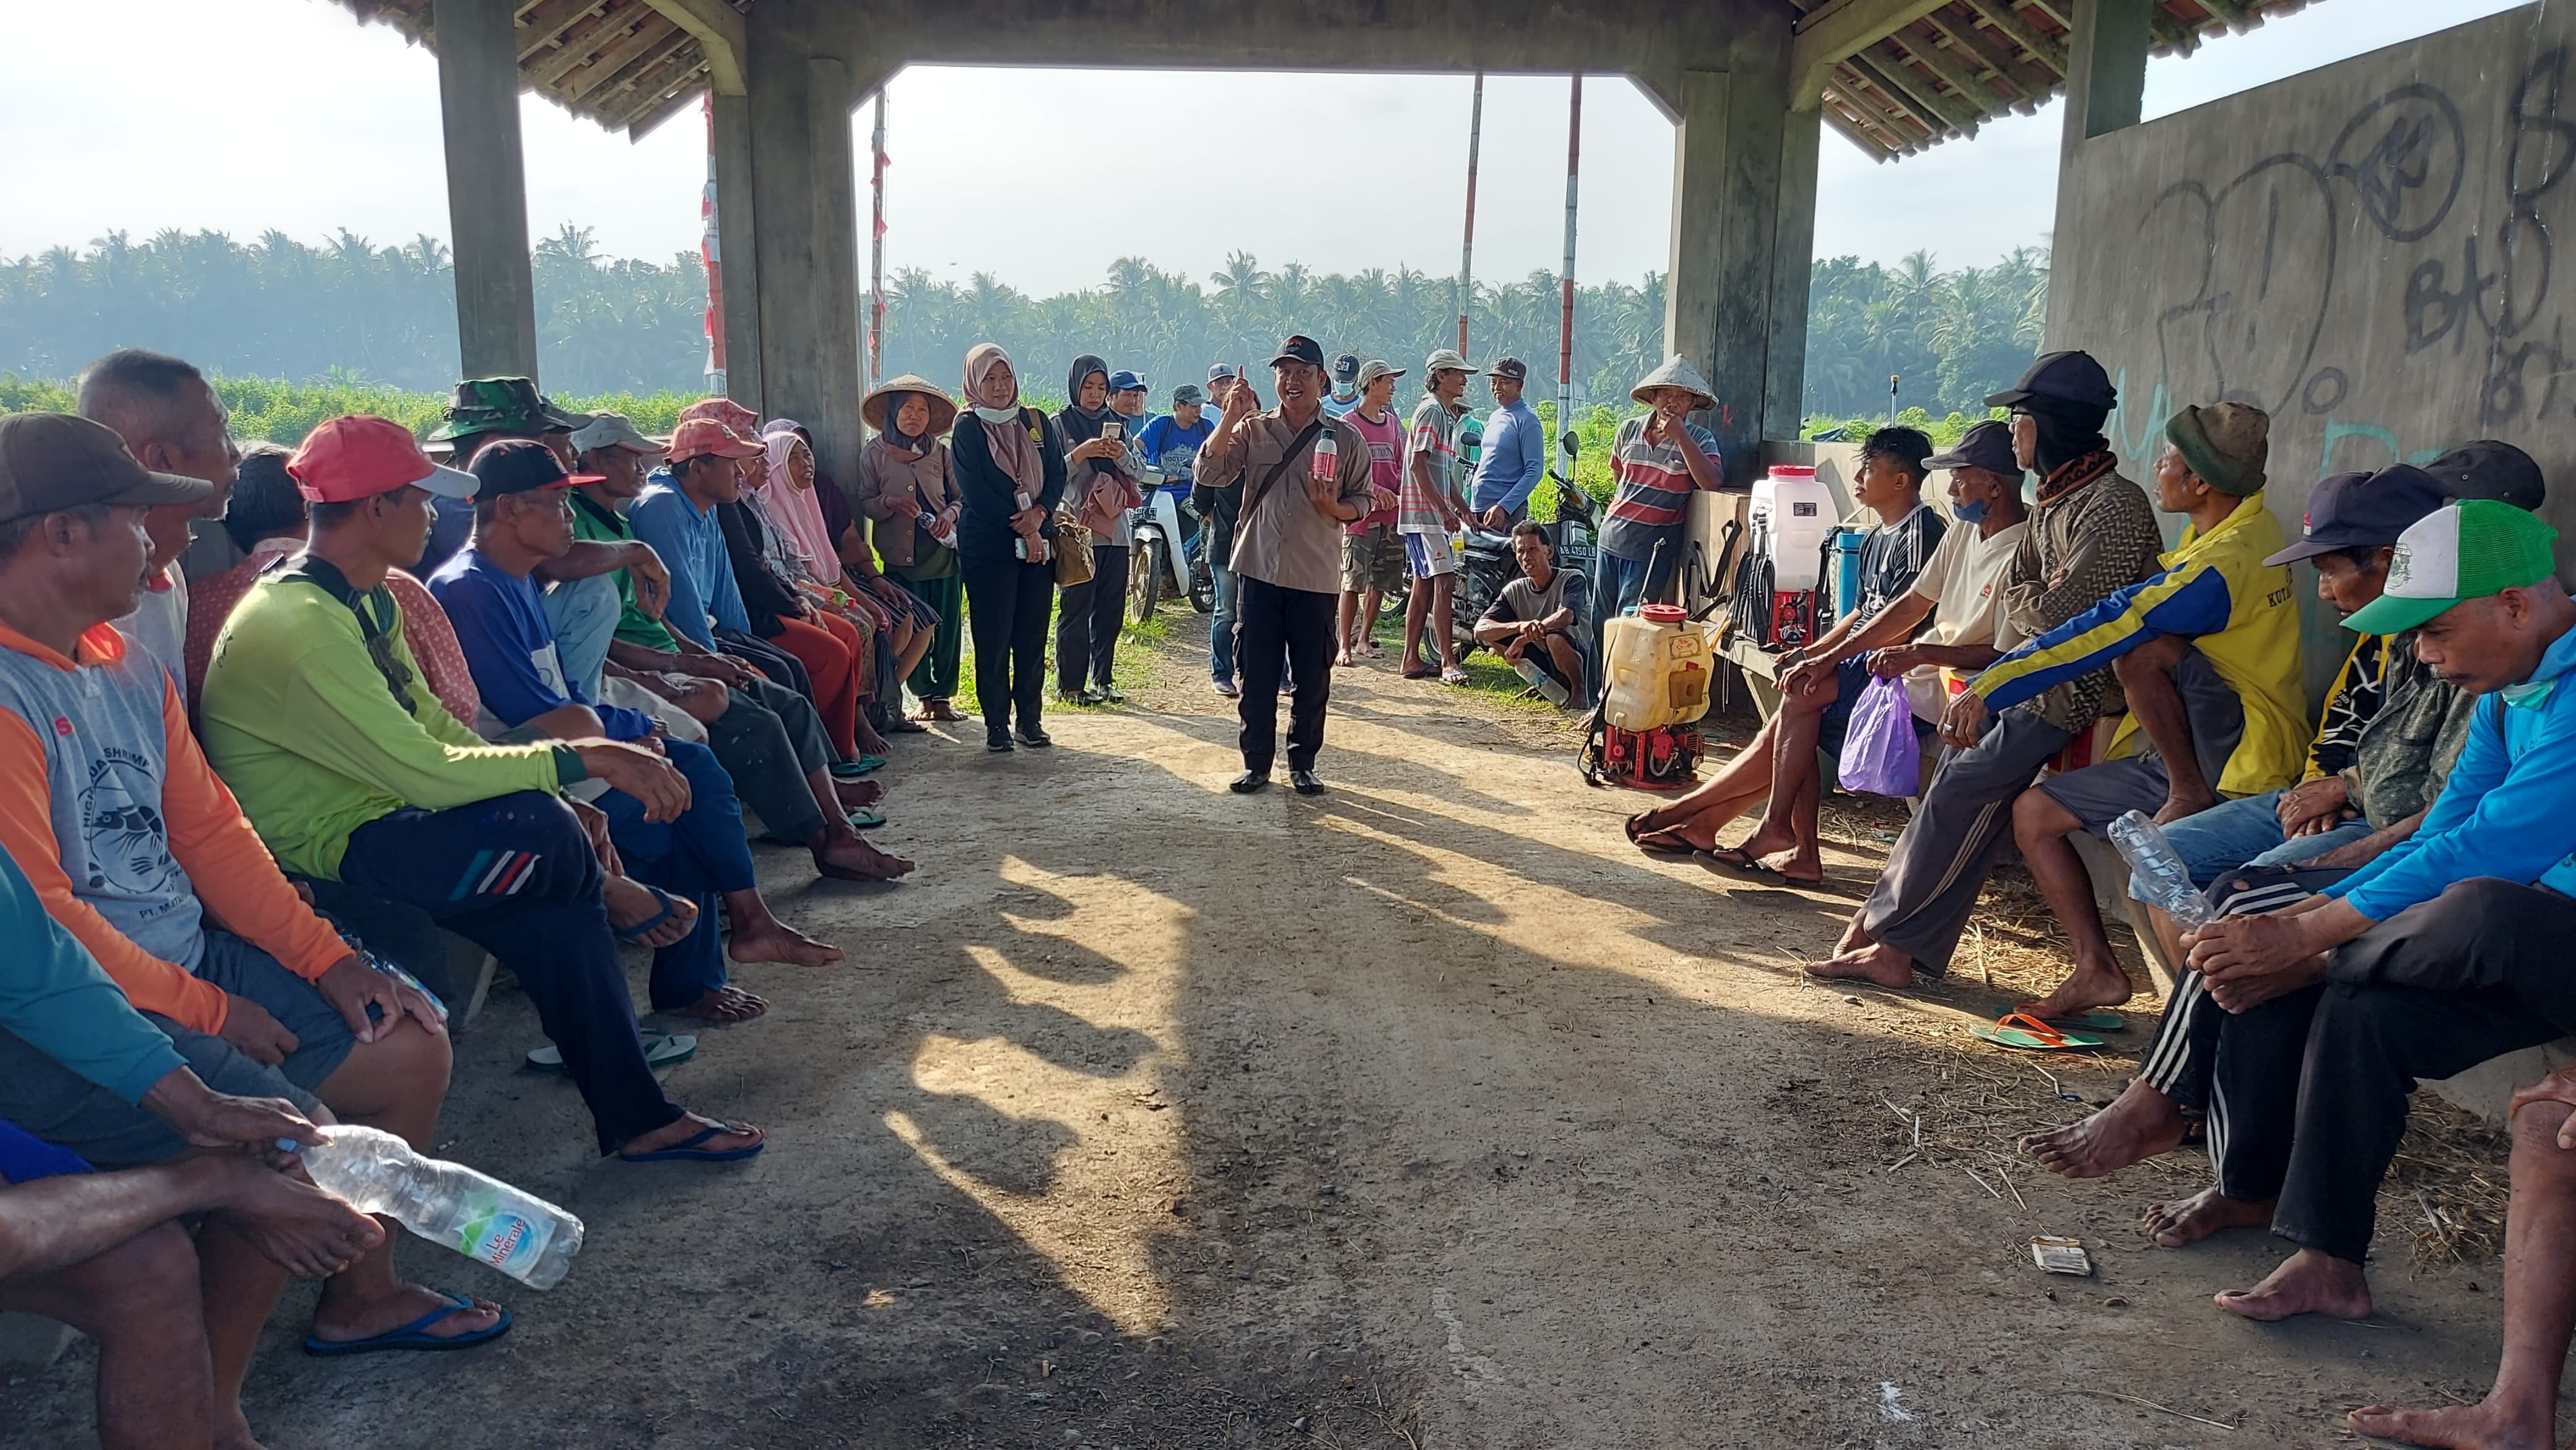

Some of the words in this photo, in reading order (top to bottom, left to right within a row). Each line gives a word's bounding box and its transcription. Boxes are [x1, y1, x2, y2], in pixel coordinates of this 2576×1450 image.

[1560, 546, 1570, 555] AB
[1572, 546, 1586, 556] 4750
[1588, 547, 1596, 557] LB
[485, 1234, 505, 1250] Le
[490, 1218, 526, 1267] Minerale
